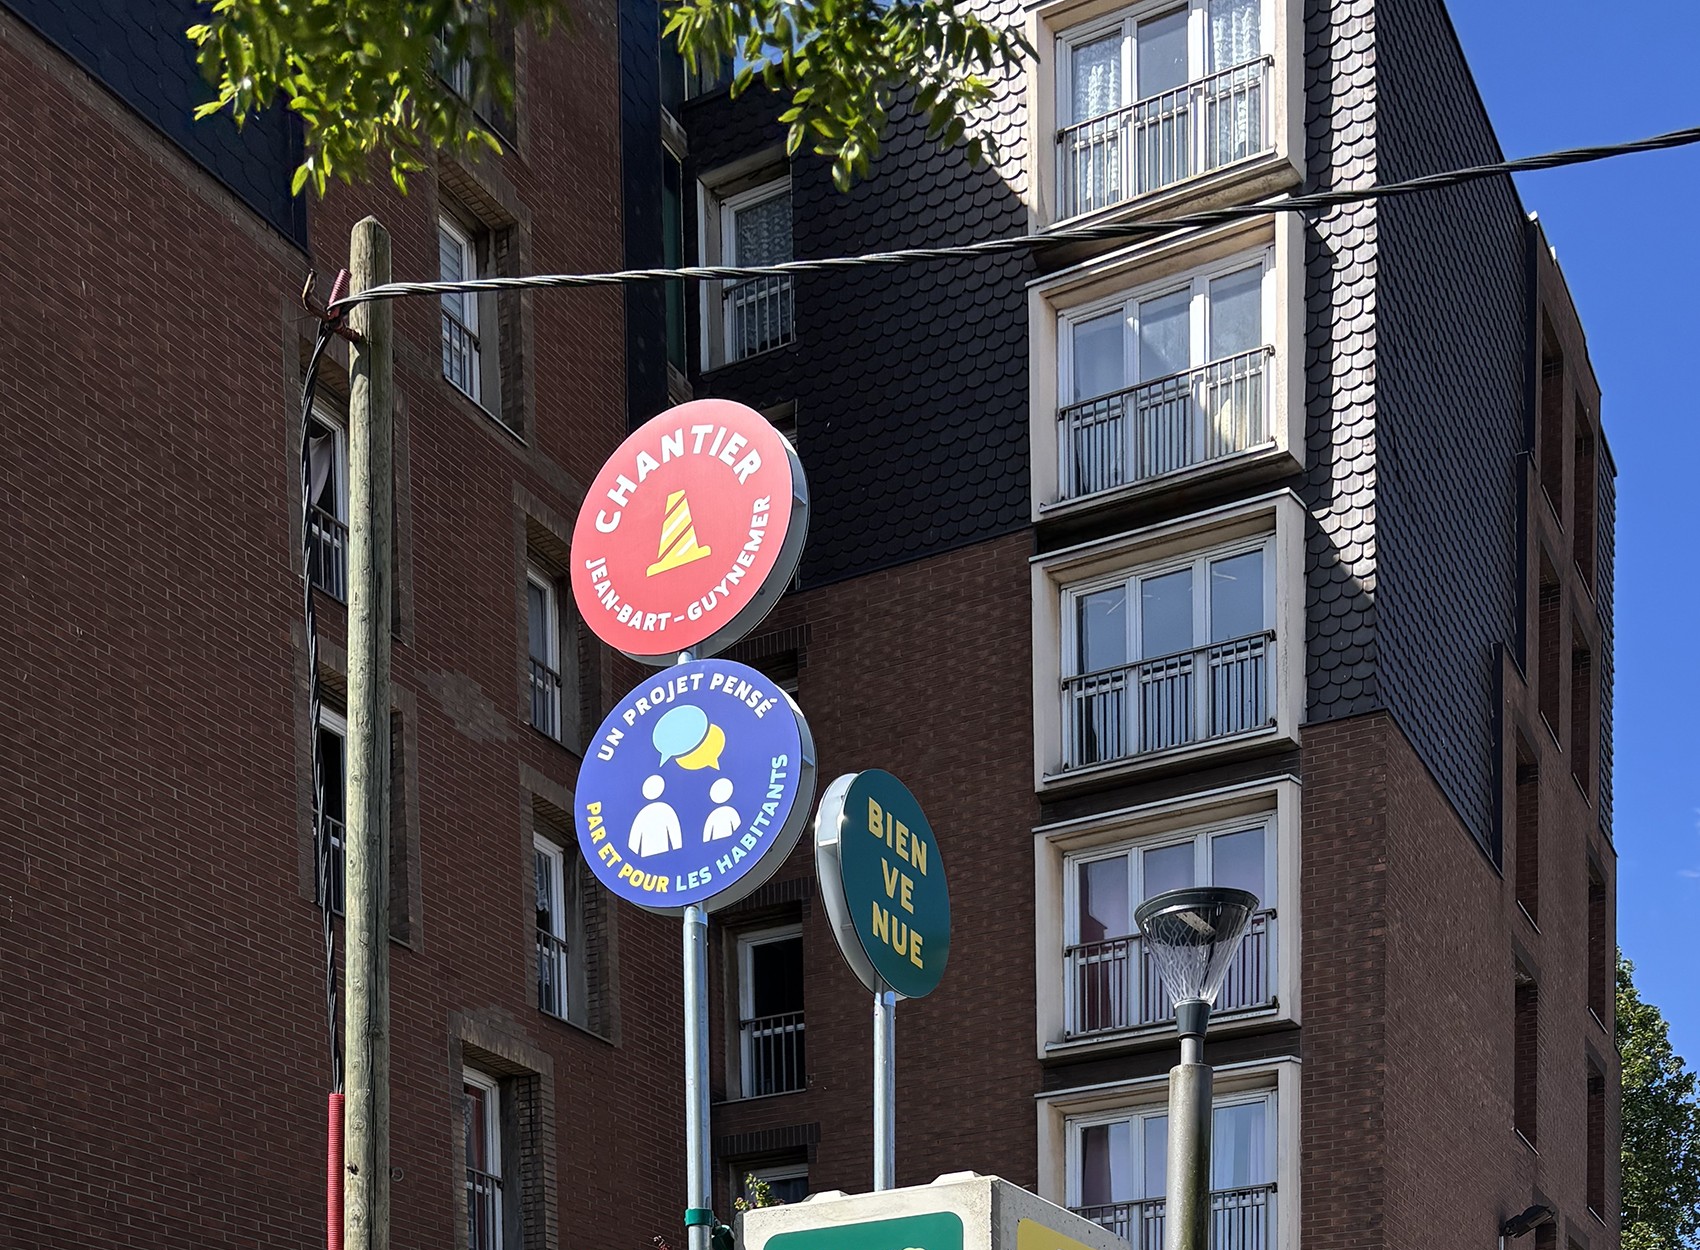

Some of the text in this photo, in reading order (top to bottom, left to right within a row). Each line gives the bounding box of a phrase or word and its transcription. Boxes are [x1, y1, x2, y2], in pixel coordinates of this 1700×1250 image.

[595, 424, 762, 533] CHANTIER
[598, 673, 778, 762] UN PROJET PENSÉ
[586, 753, 788, 892] PAR ET POUR LES HABITANTS
[868, 796, 927, 876] BIEN
[881, 857, 914, 914] VE
[872, 900, 924, 970] NUE
